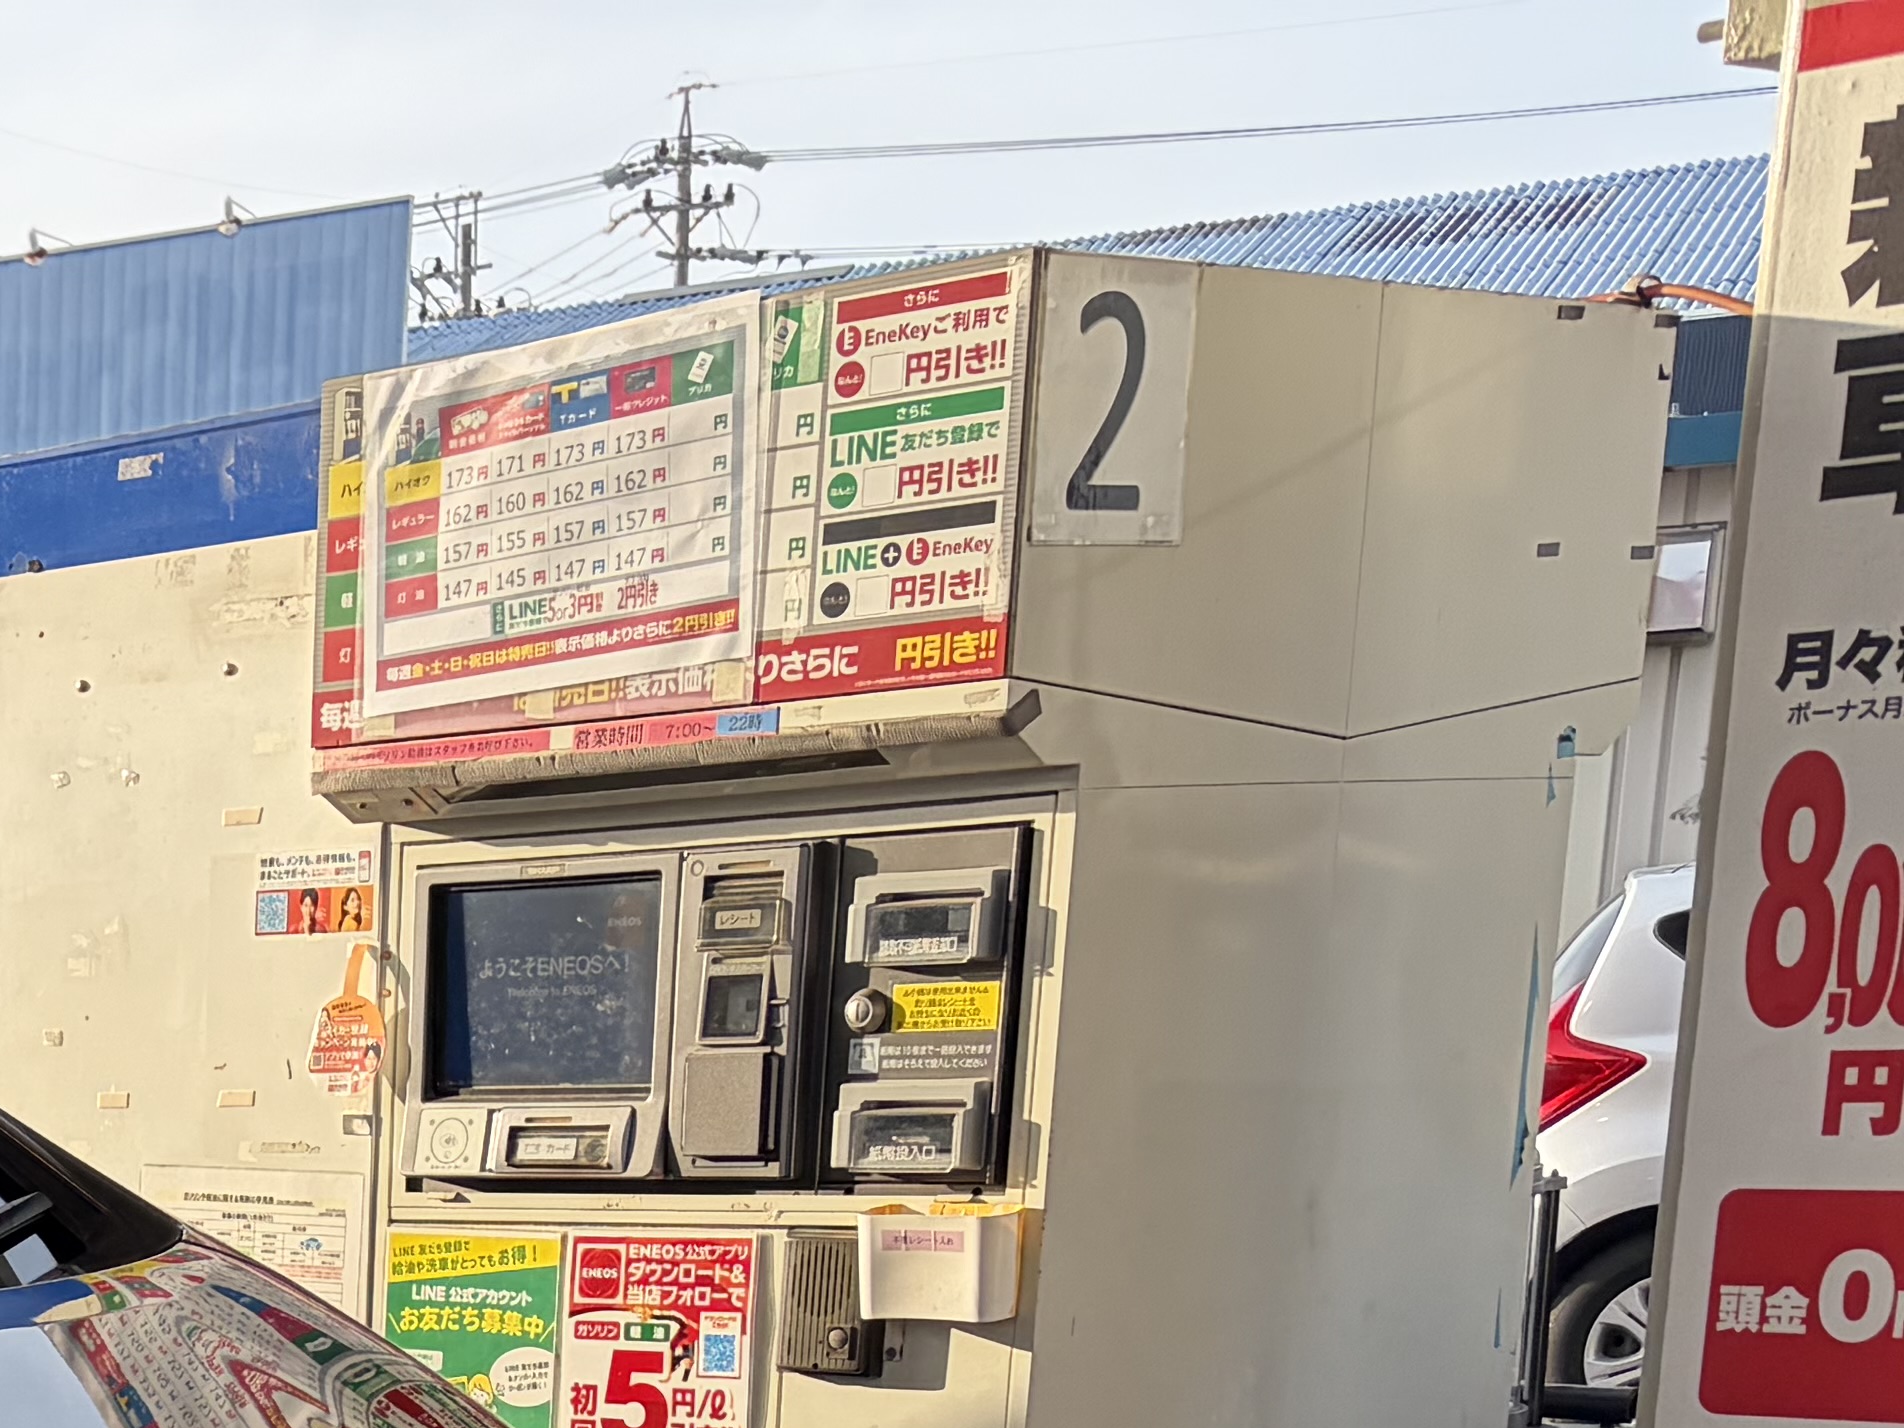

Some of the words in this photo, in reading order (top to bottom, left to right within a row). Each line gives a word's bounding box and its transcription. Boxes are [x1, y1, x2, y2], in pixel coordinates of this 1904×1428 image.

[904, 289, 940, 307] さらに
[905, 339, 1007, 387] 円引き!!
[896, 403, 932, 420] さらに
[1066, 290, 1145, 511] 2
[796, 413, 815, 437] 円
[445, 466, 475, 490] 173
[477, 466, 489, 480] 円
[496, 454, 525, 477] 171
[532, 453, 546, 469] 円
[555, 444, 585, 466] 173
[592, 440, 605, 456] 円
[615, 431, 647, 454] 173
[652, 427, 665, 443] 円
[714, 413, 728, 431] 円
[830, 429, 898, 468] LINE
[900, 420, 1000, 452] 友だち登録で
[793, 474, 810, 499] 円
[898, 454, 999, 499] 円引き!!
[445, 503, 472, 526] 162
[476, 504, 489, 519] 円
[497, 492, 526, 516] 160
[532, 492, 546, 508] 円
[553, 482, 584, 505] 162
[591, 480, 604, 495] 円
[614, 470, 647, 492] 162
[652, 467, 666, 483] 円
[713, 454, 727, 471] 円
[444, 541, 472, 564] 157
[476, 542, 489, 558] 円
[497, 530, 526, 553] 155
[533, 531, 546, 547] 円
[553, 520, 585, 544] 157
[592, 519, 605, 535] 円
[616, 508, 647, 532] 157
[652, 507, 666, 523] 円
[713, 495, 727, 512] 円
[788, 536, 806, 560] 円
[821, 545, 878, 576] LINE
[932, 536, 993, 557] EneKey
[444, 579, 472, 602] 147
[476, 581, 488, 596] 円
[496, 568, 526, 591] 145
[533, 569, 546, 585] 円
[555, 559, 585, 582] 147
[592, 559, 605, 574] 円
[615, 547, 646, 571] 147
[651, 547, 665, 563] 円
[712, 536, 725, 552] 円
[508, 598, 548, 620] LINE
[895, 629, 997, 672] 円引き!!
[1776, 629, 1904, 691] 月々
[575, 723, 644, 749] 営業時間
[728, 715, 762, 732] 22時
[720, 912, 756, 926] レシート
[562, 986, 597, 997] ENEOS
[1822, 1049, 1904, 1137] 円
[869, 1145, 935, 1161] 紙幣投入口
[393, 1245, 415, 1257] LINE
[628, 1244, 748, 1260] ENEOS公式アプリ
[582, 1267, 618, 1279] ENEOS
[628, 1261, 746, 1284] ダウンロード&
[412, 1284, 446, 1301] LINE
[449, 1286, 533, 1307] 公式アカウント
[627, 1283, 745, 1307] 当店フォローで
[400, 1306, 545, 1339] お友だち募集中
[577, 1324, 618, 1338] ガソリン
